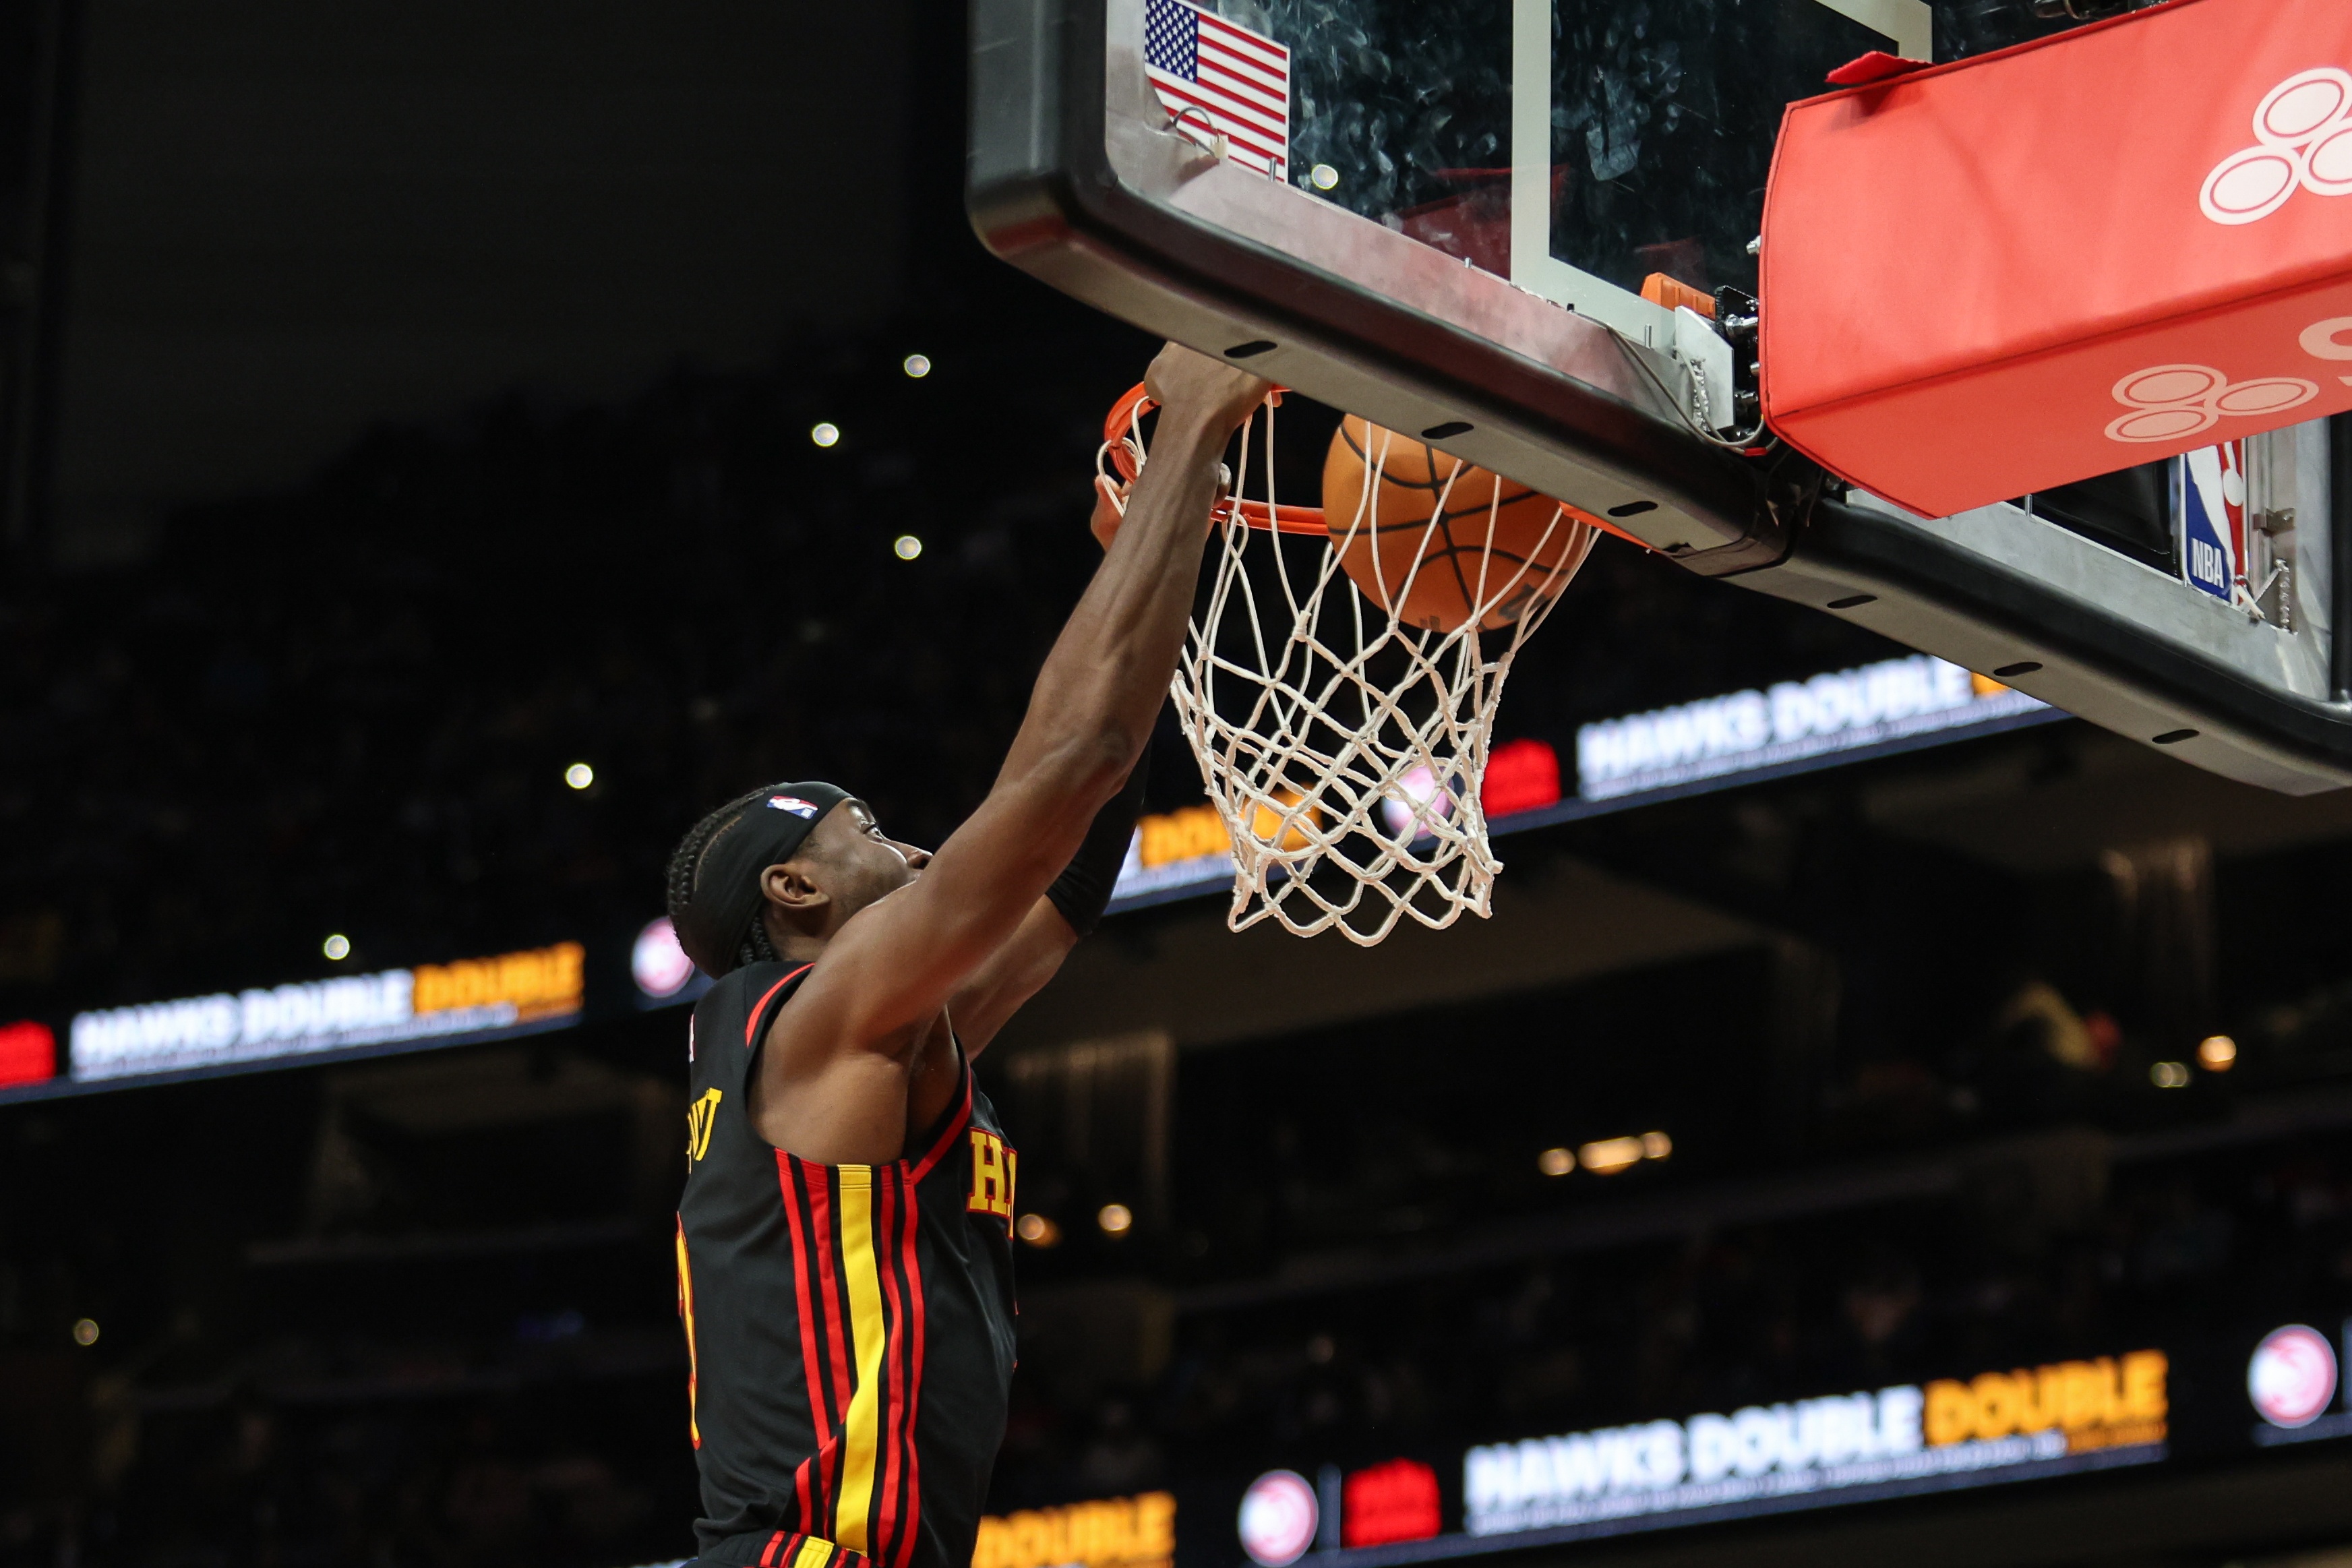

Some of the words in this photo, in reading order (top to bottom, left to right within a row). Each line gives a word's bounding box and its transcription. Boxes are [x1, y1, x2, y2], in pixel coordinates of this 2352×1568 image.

[2192, 538, 2225, 589] NBA
[1465, 1418, 1684, 1513] HAWKS
[1688, 1385, 1924, 1483] DOUBLE
[1924, 1348, 2169, 1445] DOUBLE
